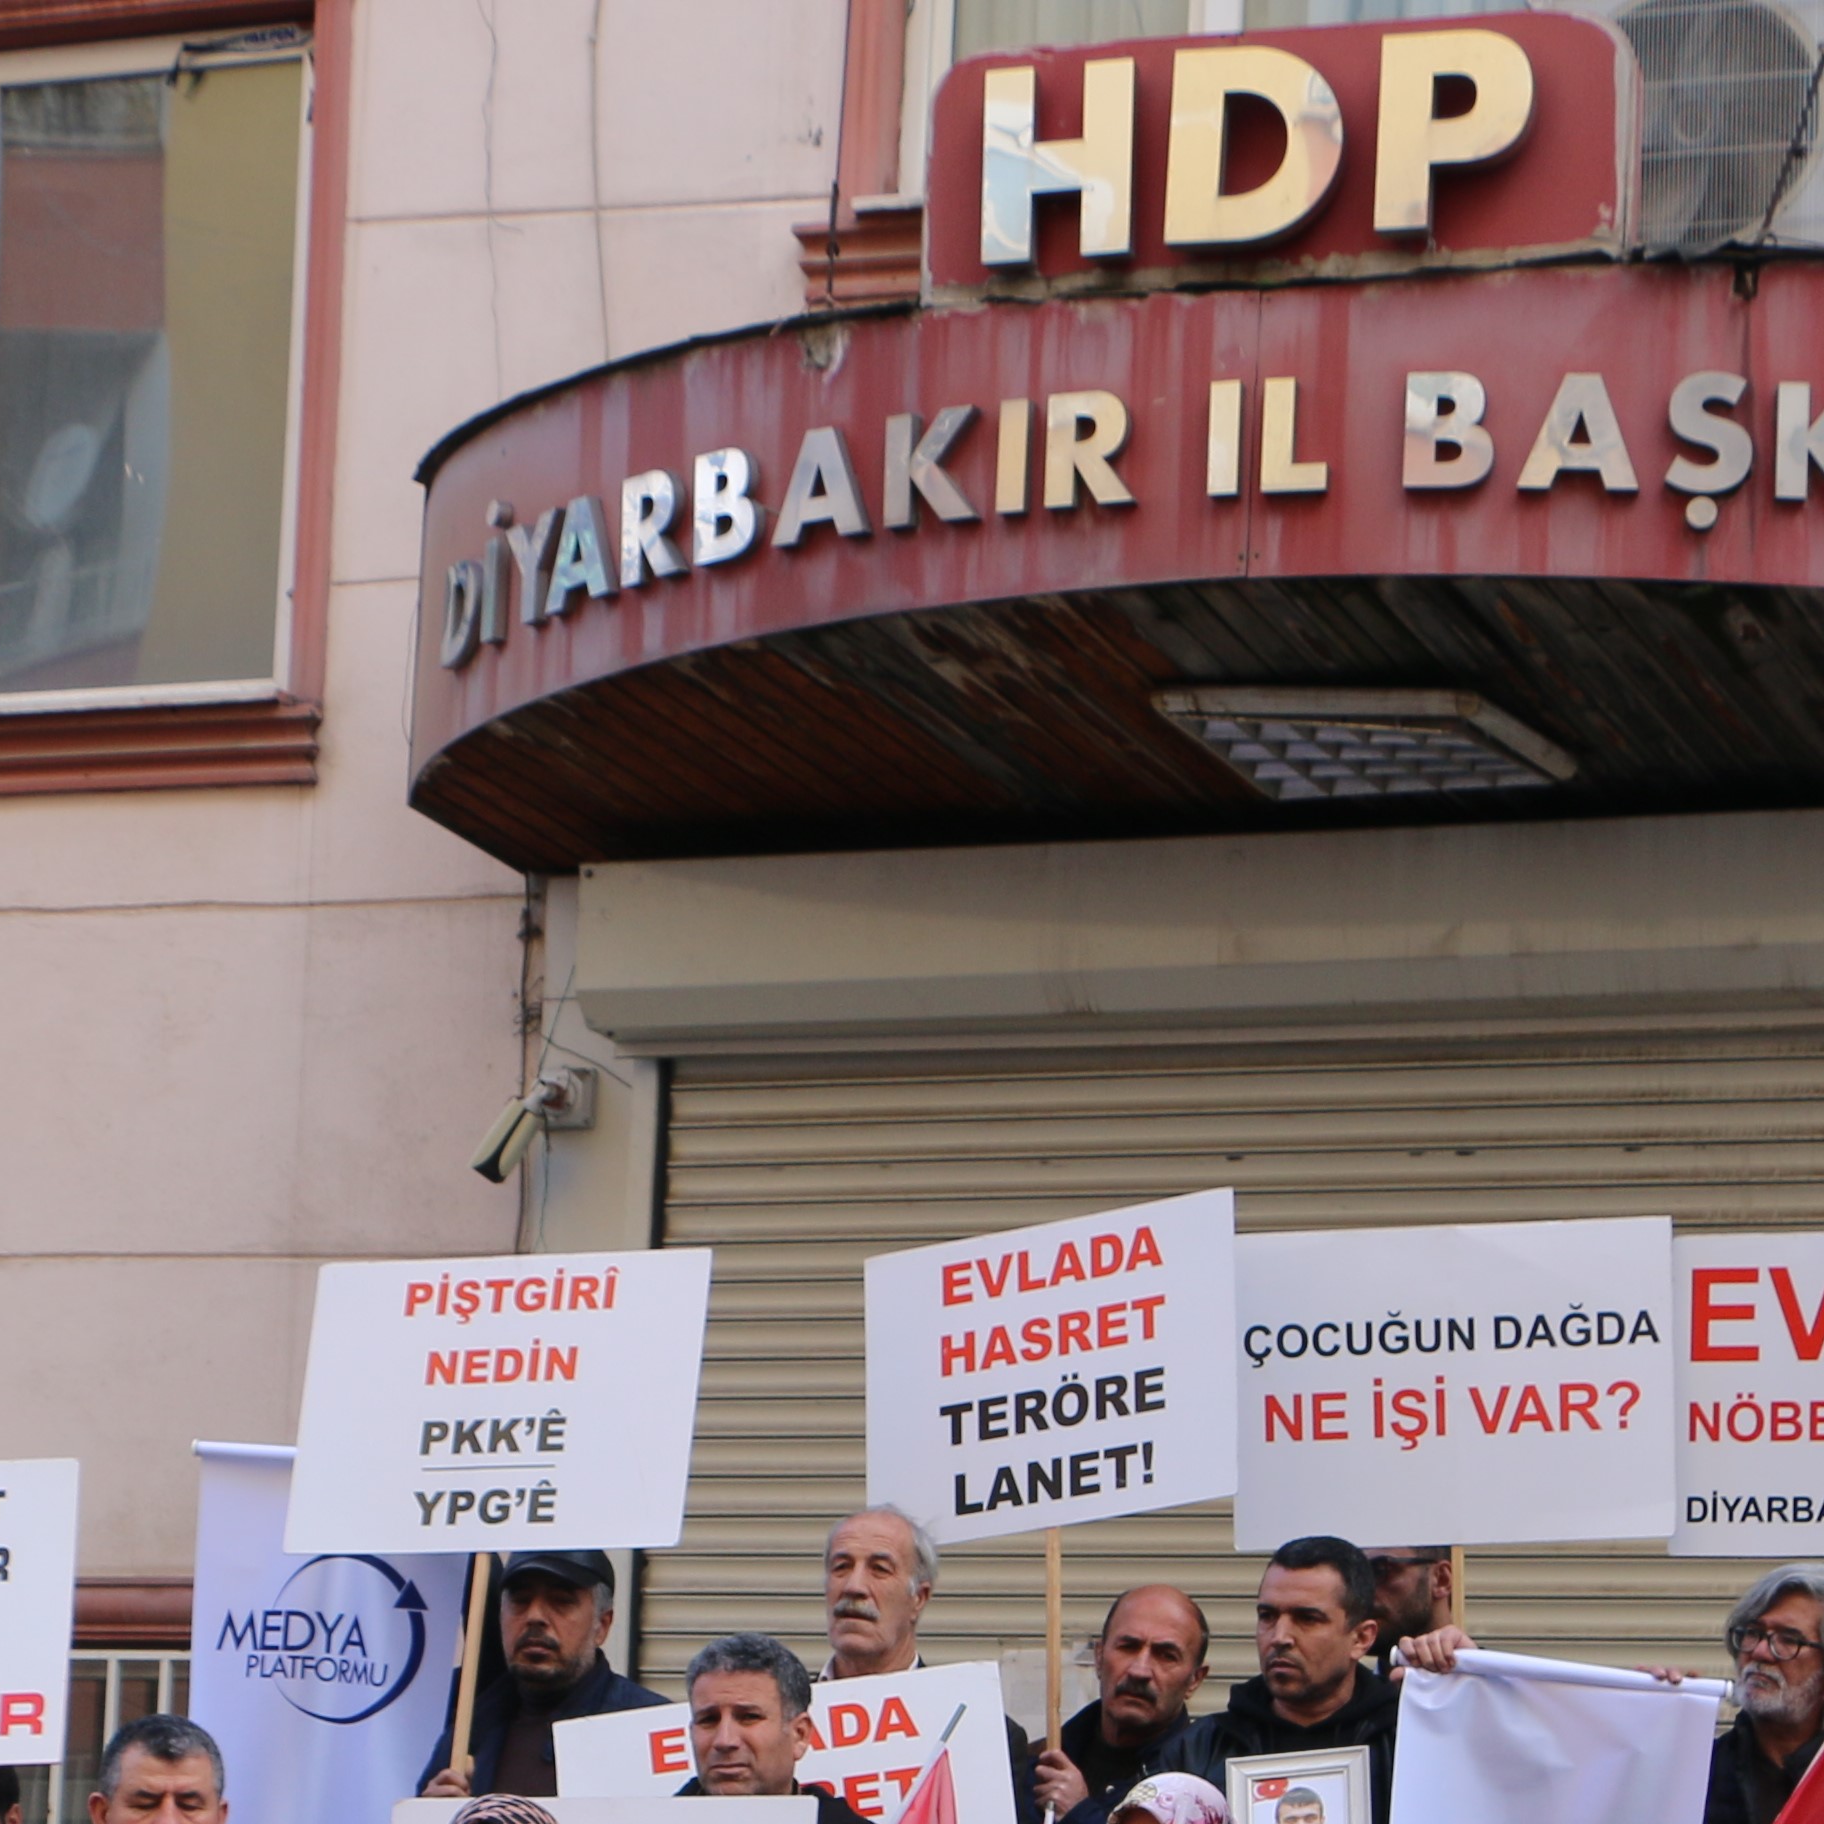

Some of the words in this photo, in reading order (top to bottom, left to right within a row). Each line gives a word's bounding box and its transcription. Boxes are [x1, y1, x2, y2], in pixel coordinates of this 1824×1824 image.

[980, 29, 1534, 265] HDP
[441, 390, 1135, 669] DİYARBAKIR
[941, 1225, 1164, 1307] EVLADA
[425, 1338, 579, 1386] NEDİN
[940, 1294, 1166, 1378] HASRET
[1242, 1310, 1476, 1369] ÇOCUĞUN
[1492, 1303, 1660, 1351] DAĞDA
[939, 1366, 1167, 1447] TERÖRE
[1263, 1391, 1350, 1443] NE
[1372, 1374, 1447, 1452] İŞİ
[1467, 1380, 1641, 1435] VAR?
[953, 1440, 1154, 1516] LANET!
[216, 1609, 368, 1658] MEDYA
[245, 1653, 389, 1687] PLATFORMU
